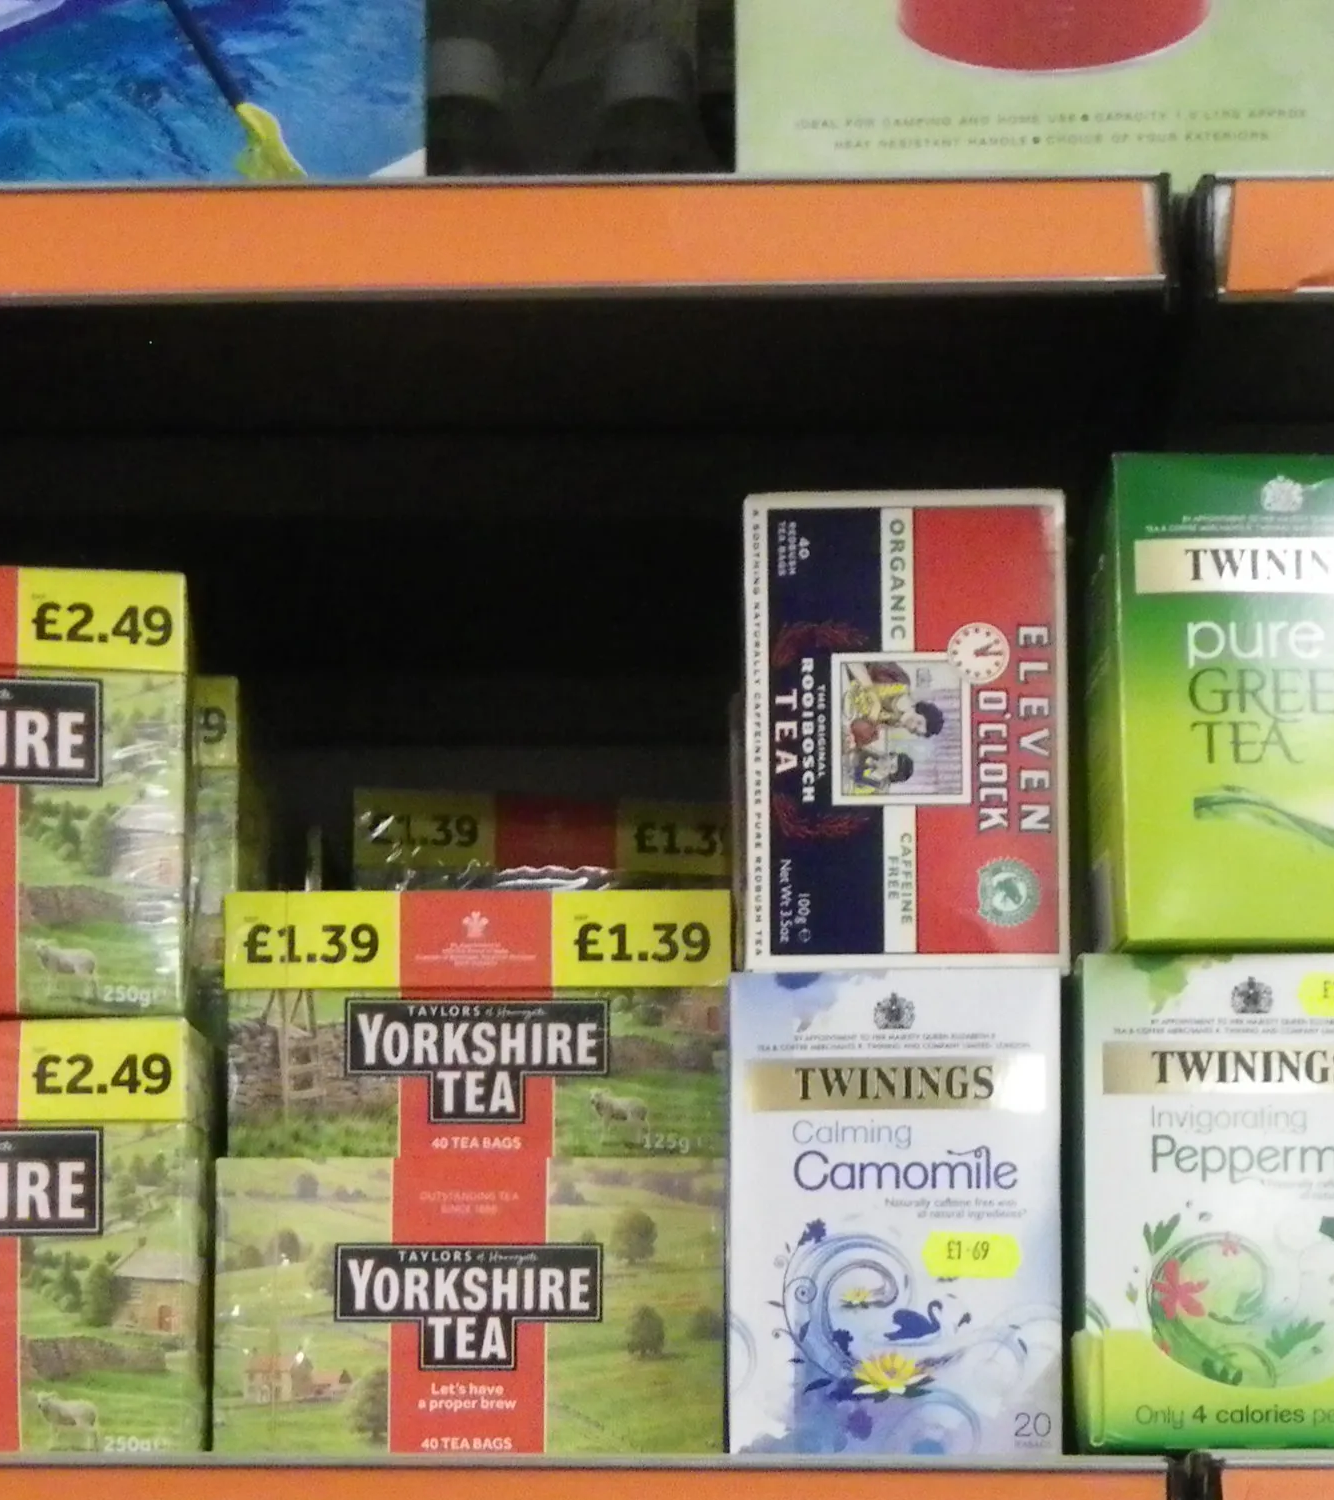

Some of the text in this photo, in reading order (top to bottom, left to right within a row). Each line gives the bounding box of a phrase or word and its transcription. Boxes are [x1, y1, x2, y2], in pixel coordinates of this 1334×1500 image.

[798, 537, 810, 559] 40
[889, 518, 908, 641] ORGANIC
[32, 603, 174, 647] £2.49
[1186, 620, 1325, 667] pure
[774, 690, 798, 775] TEA
[800, 657, 815, 803] ROOIBOSCH
[1016, 624, 1051, 834] ELEVEN
[1190, 720, 1303, 765] TEA
[977, 688, 1010, 831] O'CLOCK
[887, 855, 899, 902] FREE
[900, 832, 913, 925] CAFFEINE
[243, 923, 380, 964] £1.39
[575, 922, 711, 963] £1.39
[408, 1004, 480, 1018] TAYLORS
[358, 1012, 597, 1067] YORKSHIRE
[33, 1053, 173, 1096] £2.49
[437, 1071, 516, 1114] TEA
[795, 1065, 995, 1100] TWININGS
[792, 1119, 912, 1148] Calming
[1150, 1105, 1308, 1133] Invigorating
[432, 1136, 522, 1150] 40 TEA BAGS
[794, 1145, 1019, 1191] Camomile
[399, 1250, 473, 1263] TAYLORS
[347, 1259, 591, 1312] YORKSHIRE
[427, 1318, 507, 1360] TEA
[429, 1397, 516, 1412] proper brew
[469, 1383, 504, 1396] have
[1014, 1412, 1052, 1438] 20
[1135, 1404, 1185, 1428] Only
[1192, 1405, 1207, 1424] 4
[1215, 1404, 1305, 1424] calories
[421, 1438, 513, 1451] 40 TEA BAGS
